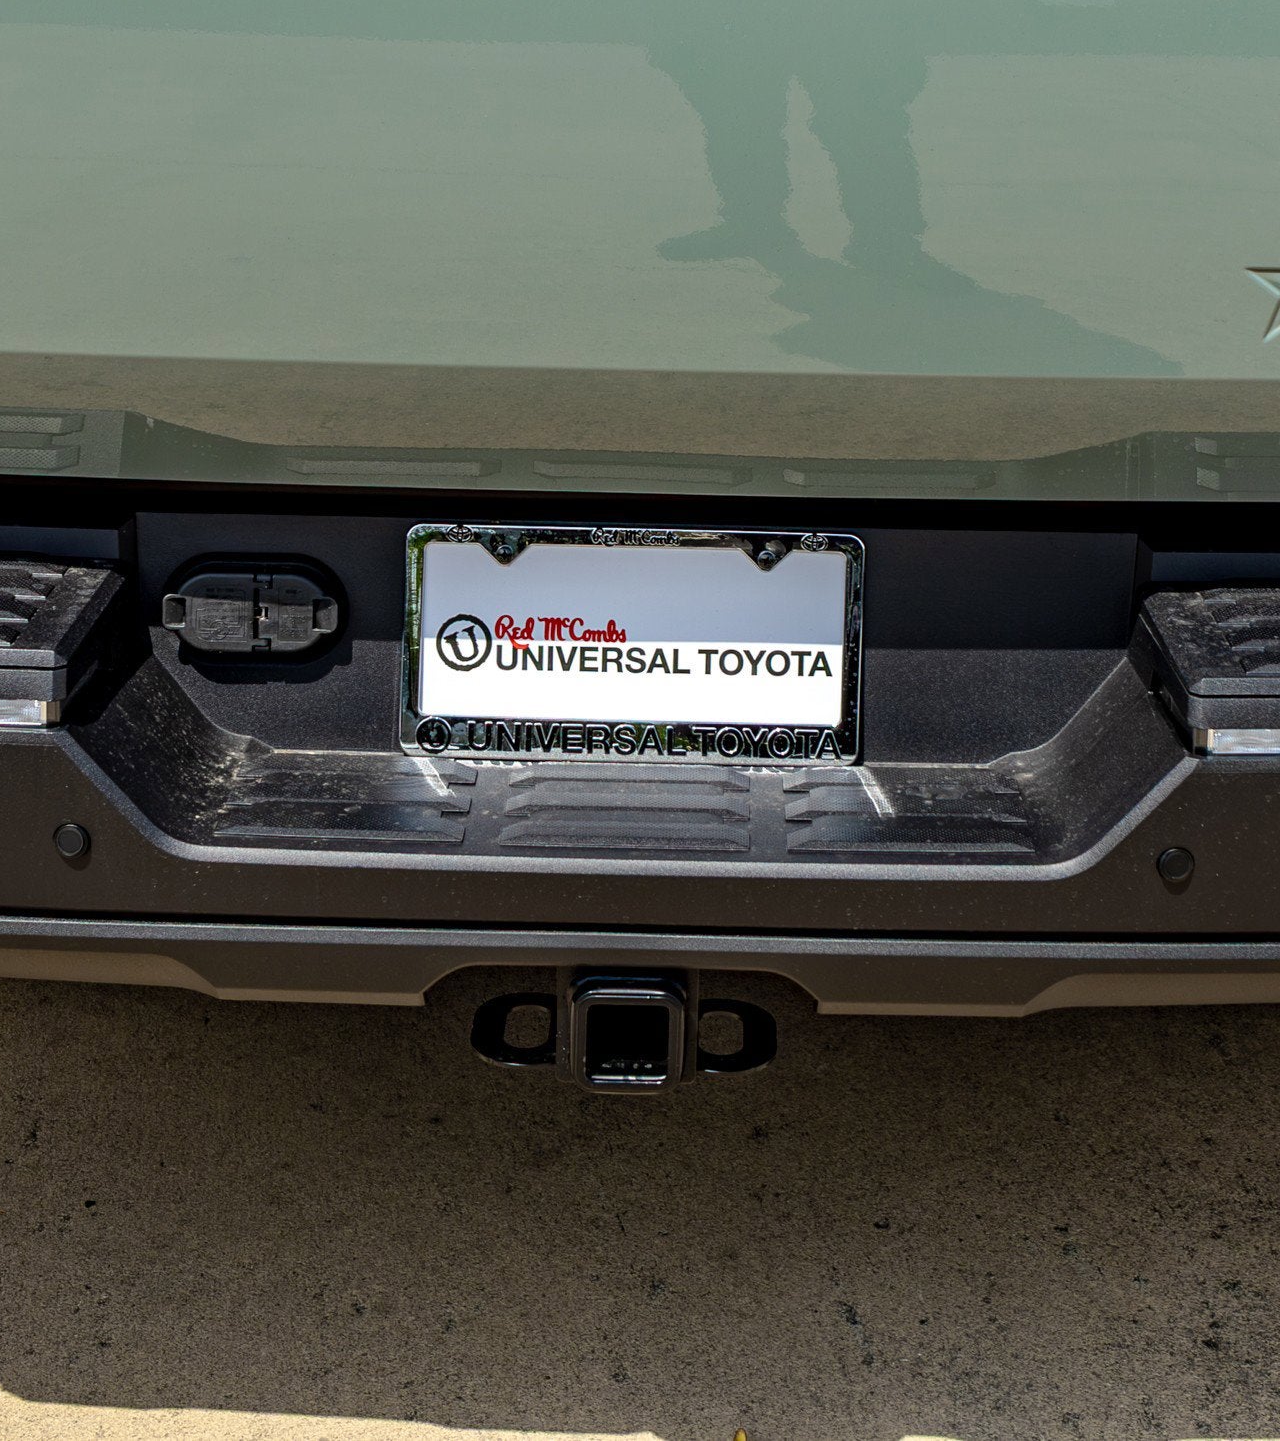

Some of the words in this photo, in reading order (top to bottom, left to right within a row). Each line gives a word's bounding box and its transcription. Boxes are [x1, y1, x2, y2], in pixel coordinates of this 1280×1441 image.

[494, 614, 535, 650] Red
[538, 616, 627, 643] McCombs
[495, 644, 691, 675] UNIVERSAL
[697, 648, 833, 678] TOYOTA
[466, 719, 688, 756] UNIVERSAL
[691, 726, 844, 760] TOYOTA
